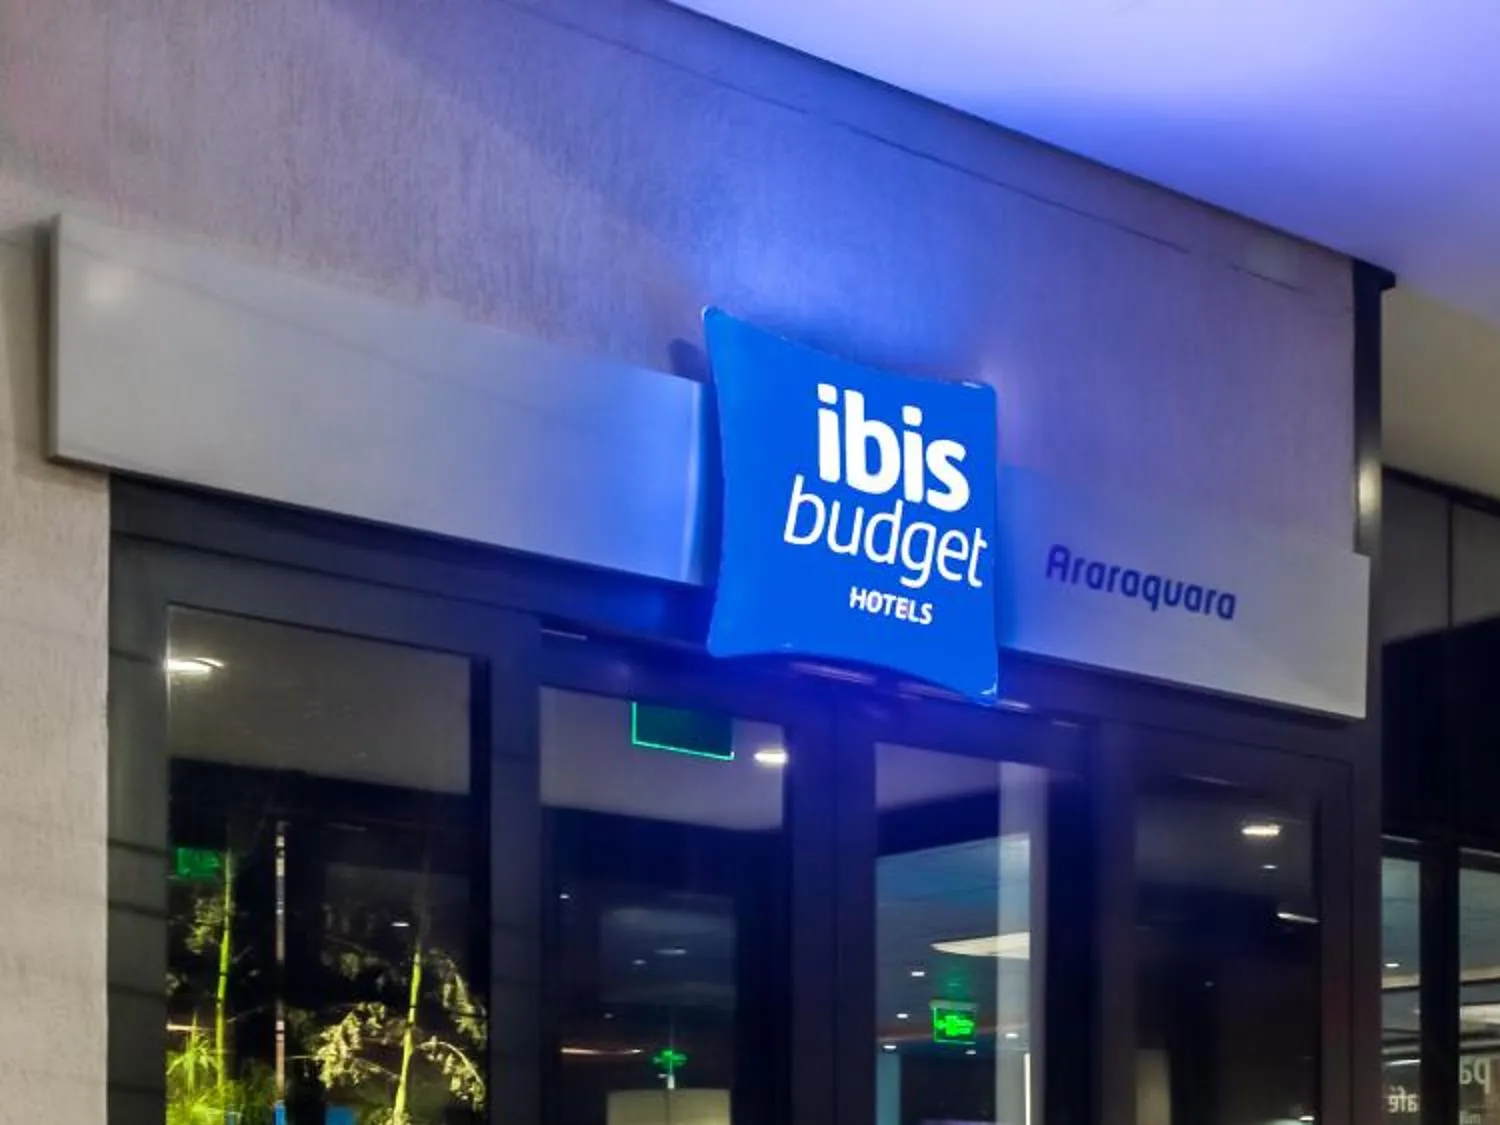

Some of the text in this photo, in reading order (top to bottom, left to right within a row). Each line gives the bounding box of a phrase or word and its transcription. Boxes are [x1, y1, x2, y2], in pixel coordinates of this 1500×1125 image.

[817, 383, 971, 513] ibis
[783, 473, 989, 589] budget
[849, 586, 933, 625] HOTELS
[1045, 544, 1237, 620] Araraquara
